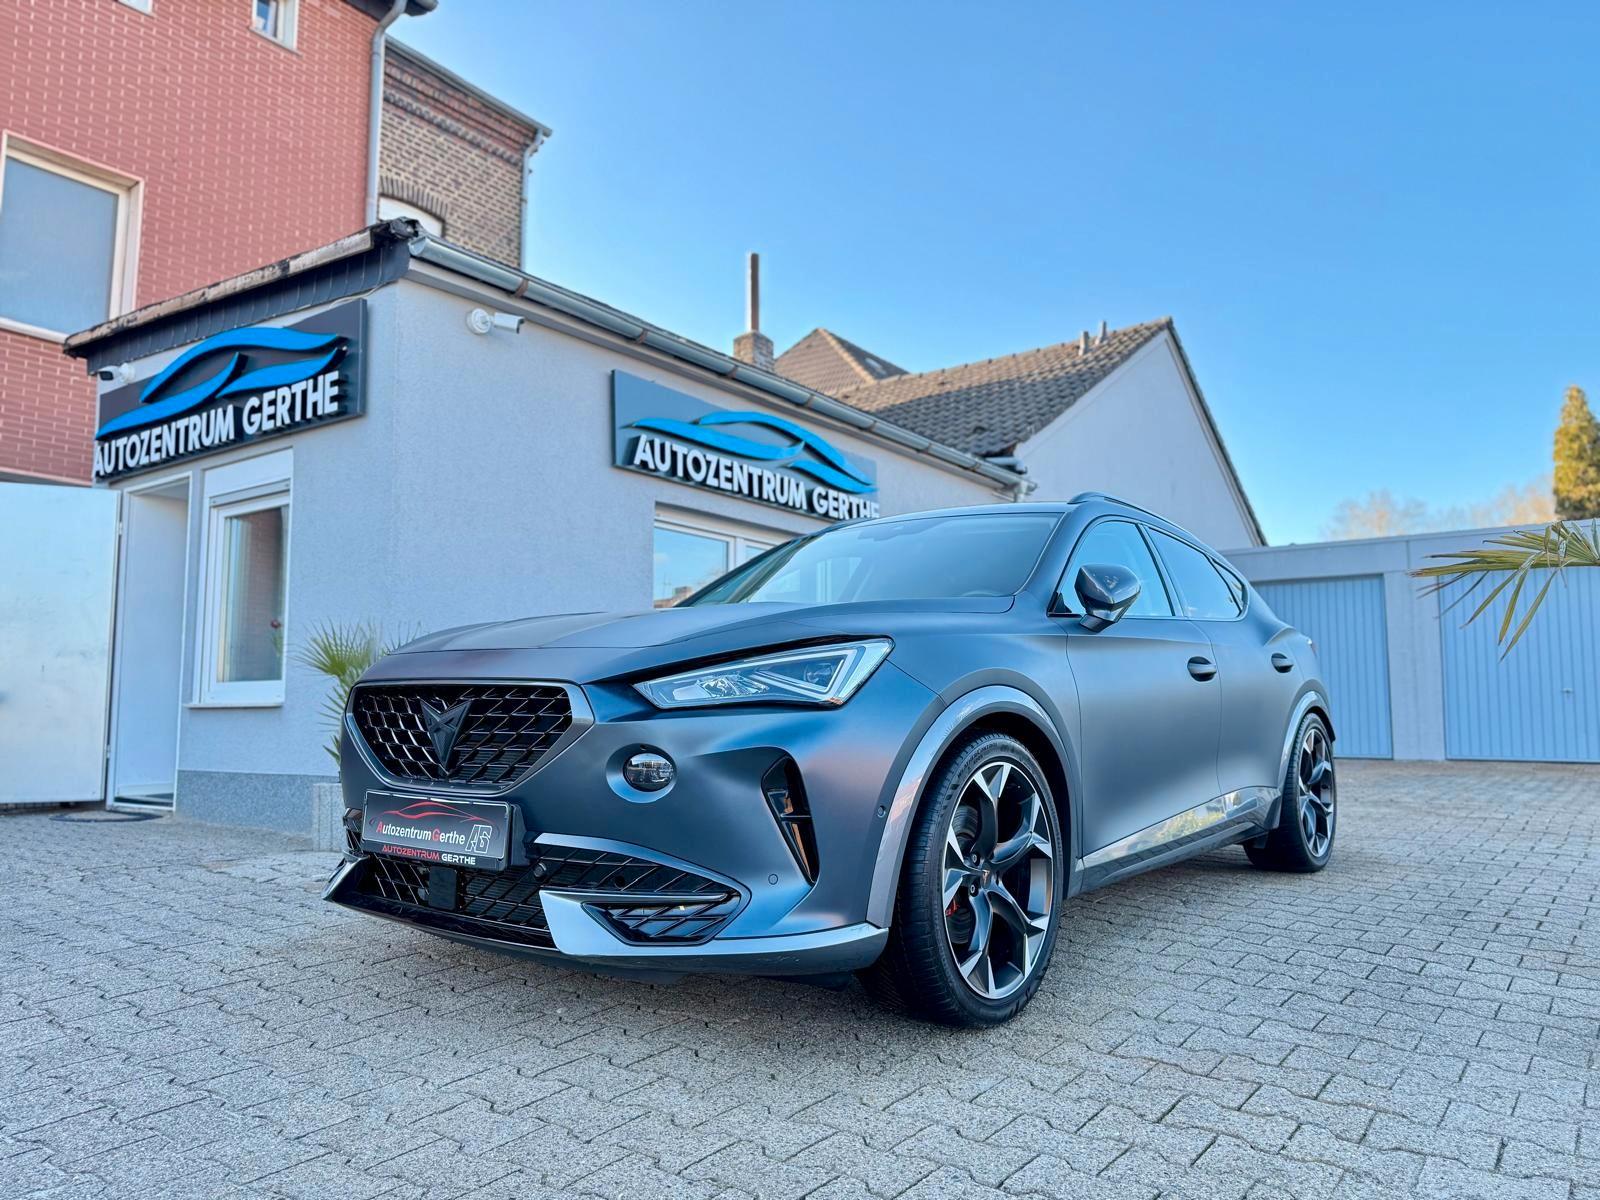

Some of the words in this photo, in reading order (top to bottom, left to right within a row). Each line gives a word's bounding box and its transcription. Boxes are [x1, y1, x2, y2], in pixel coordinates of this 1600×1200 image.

[92, 404, 235, 477] AUTOZENTRUM
[242, 370, 339, 435] GERTHE
[633, 434, 807, 510] AUTOZENTRUM
[812, 486, 880, 520] GERTHE
[376, 821, 431, 841] Autozentrum
[382, 845, 440, 860] AUTOZENTRUM
[441, 854, 476, 865] GERTHE
